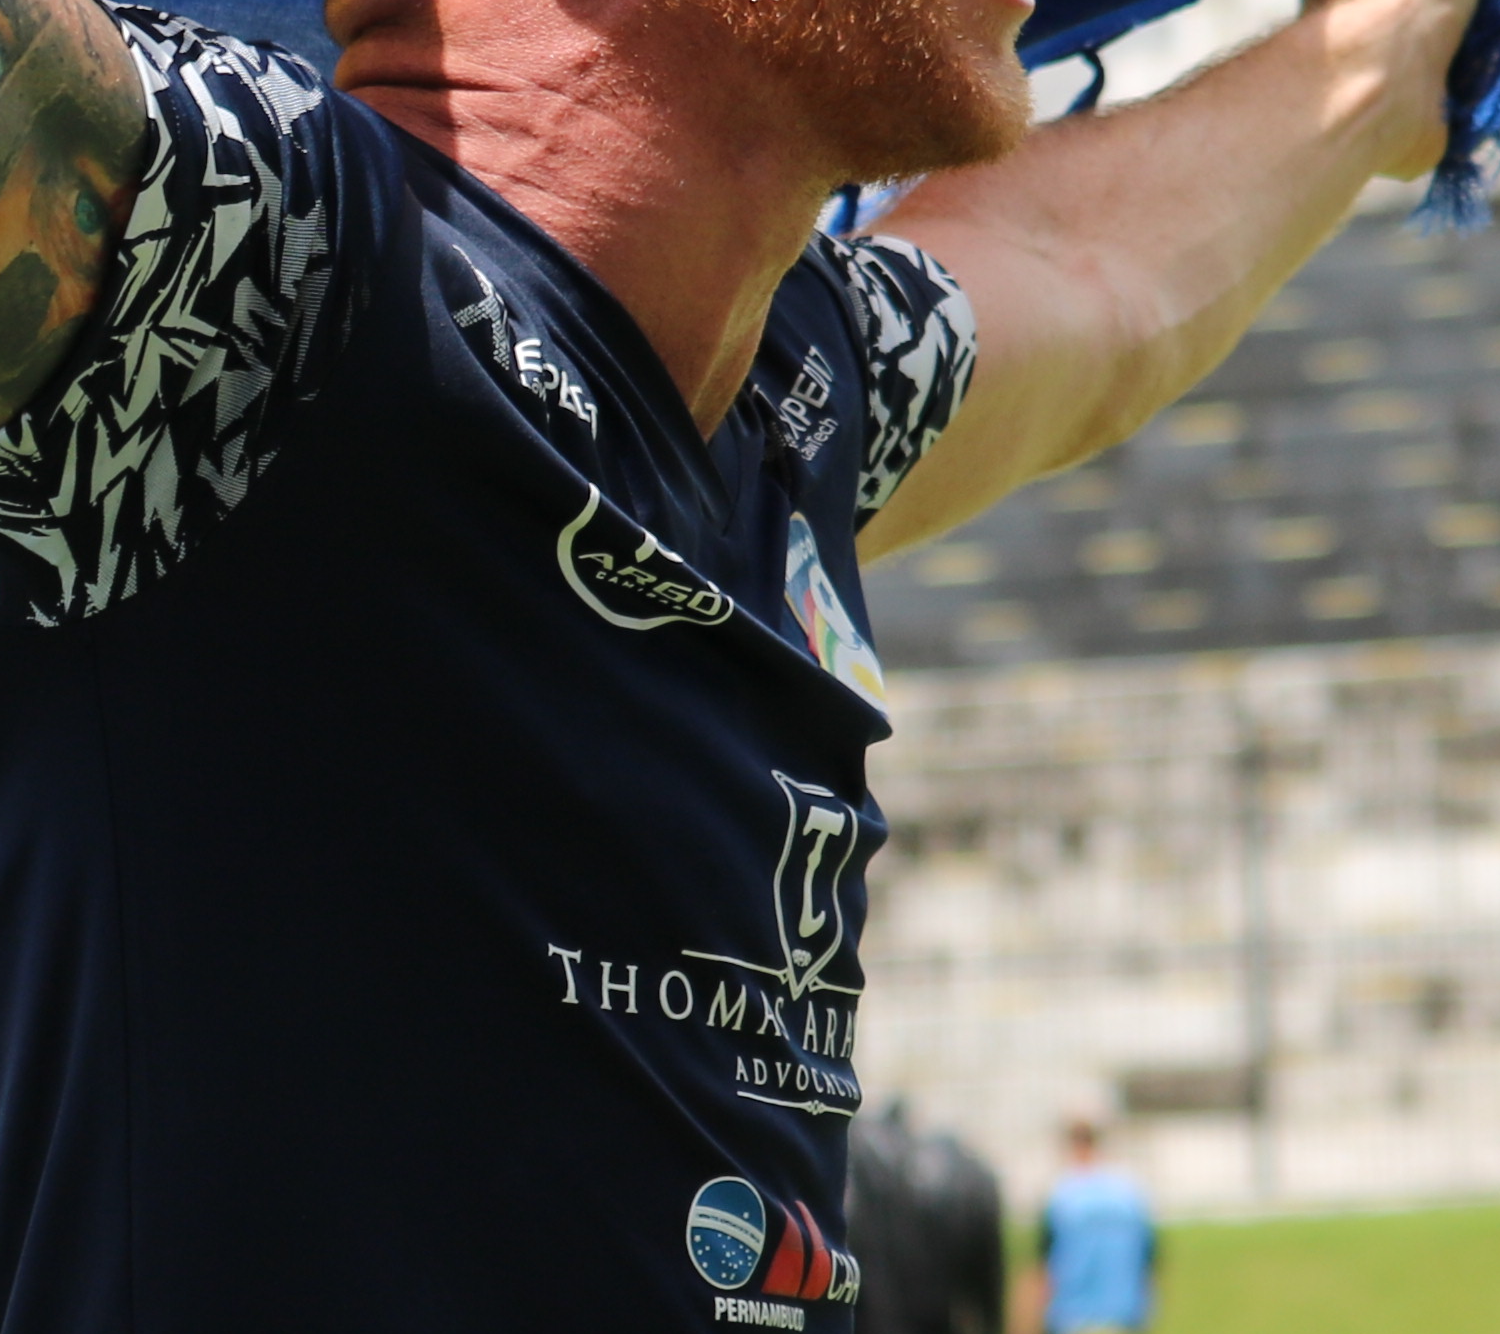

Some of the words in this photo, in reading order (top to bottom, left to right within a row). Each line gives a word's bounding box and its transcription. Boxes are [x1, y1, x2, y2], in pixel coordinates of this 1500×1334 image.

[578, 553, 722, 616] ARGO
[548, 942, 790, 1041] THOMAS
[714, 1296, 805, 1332] PERNAMBUCO
